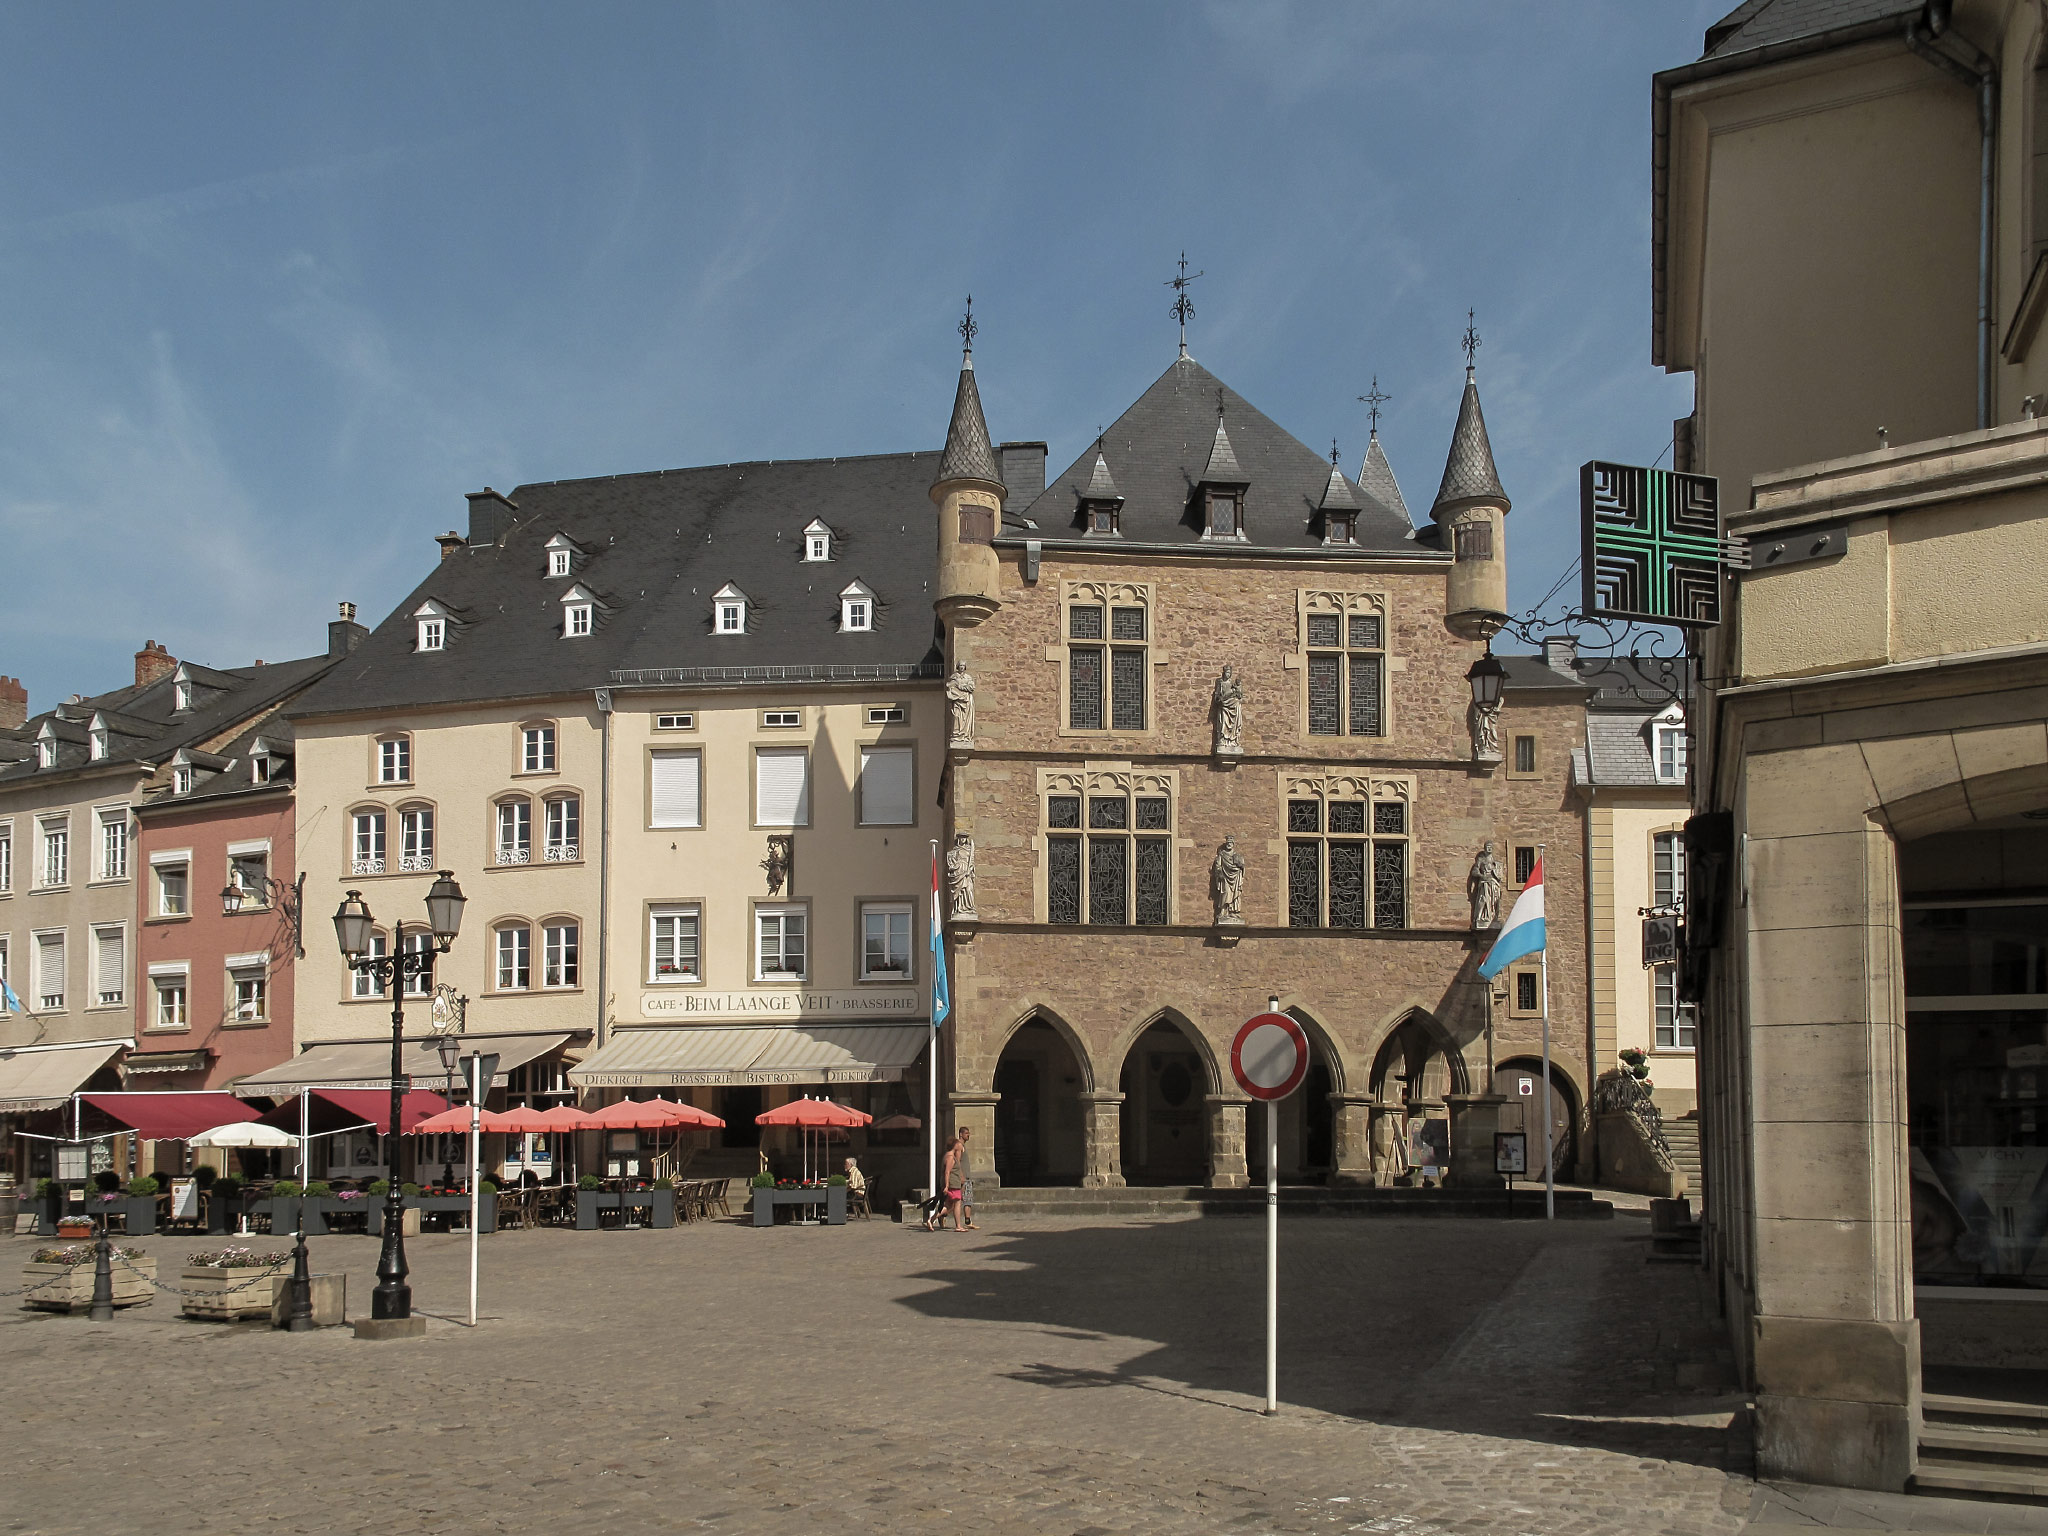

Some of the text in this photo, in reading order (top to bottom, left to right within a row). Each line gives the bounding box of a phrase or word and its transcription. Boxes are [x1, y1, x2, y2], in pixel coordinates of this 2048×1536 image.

[1646, 944, 1673, 960] ING
[648, 993, 915, 1012] CAFE BEIM LAANGE VEIT BRASSERIE
[585, 1071, 884, 1085] DIEKIRCH BRASSERIE BISTROT DIEKIRCH
[1977, 1150, 2025, 1161] VICHY
